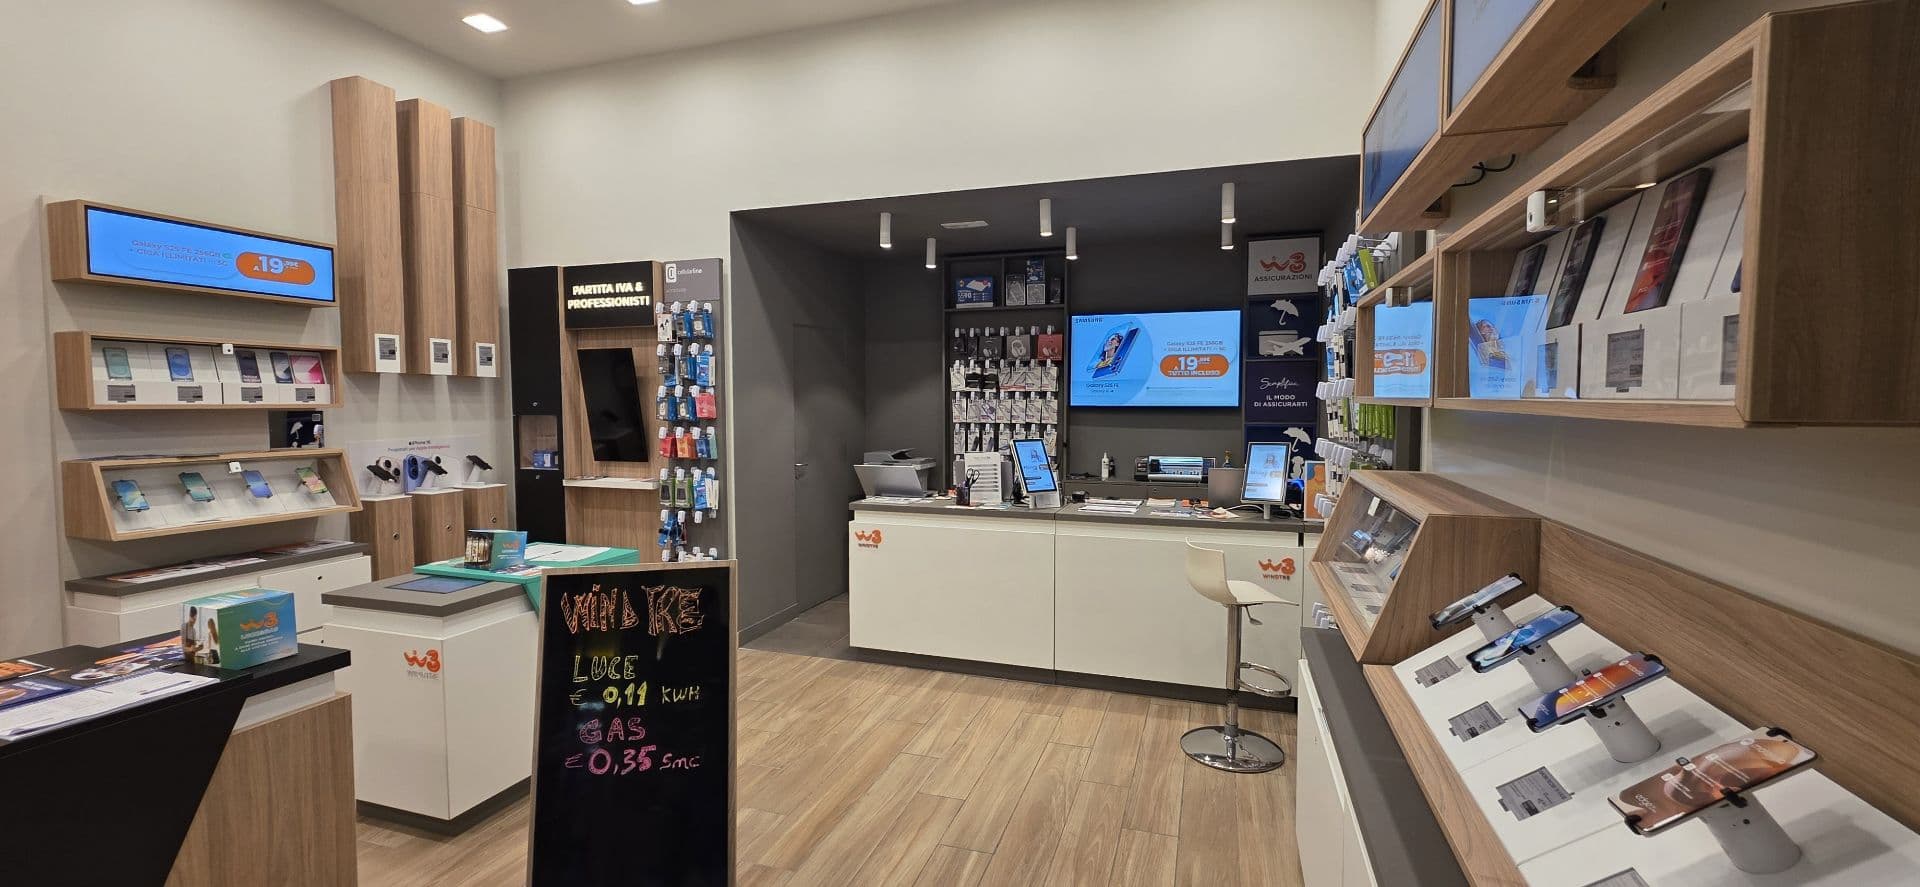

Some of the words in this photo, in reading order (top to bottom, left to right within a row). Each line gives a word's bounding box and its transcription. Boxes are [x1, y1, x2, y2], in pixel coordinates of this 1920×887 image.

[1254, 274, 1312, 282] ASSICURAZIONI
[572, 283, 615, 296] PARTITA
[616, 282, 634, 293] IVA
[635, 282, 643, 292] &
[567, 295, 650, 310] PROFESSIONISTI
[1263, 573, 1290, 581] WINDTRE
[641, 584, 705, 636] TRE
[572, 655, 639, 682] LUCE
[602, 681, 648, 709] 0,11
[579, 717, 646, 744] GAS
